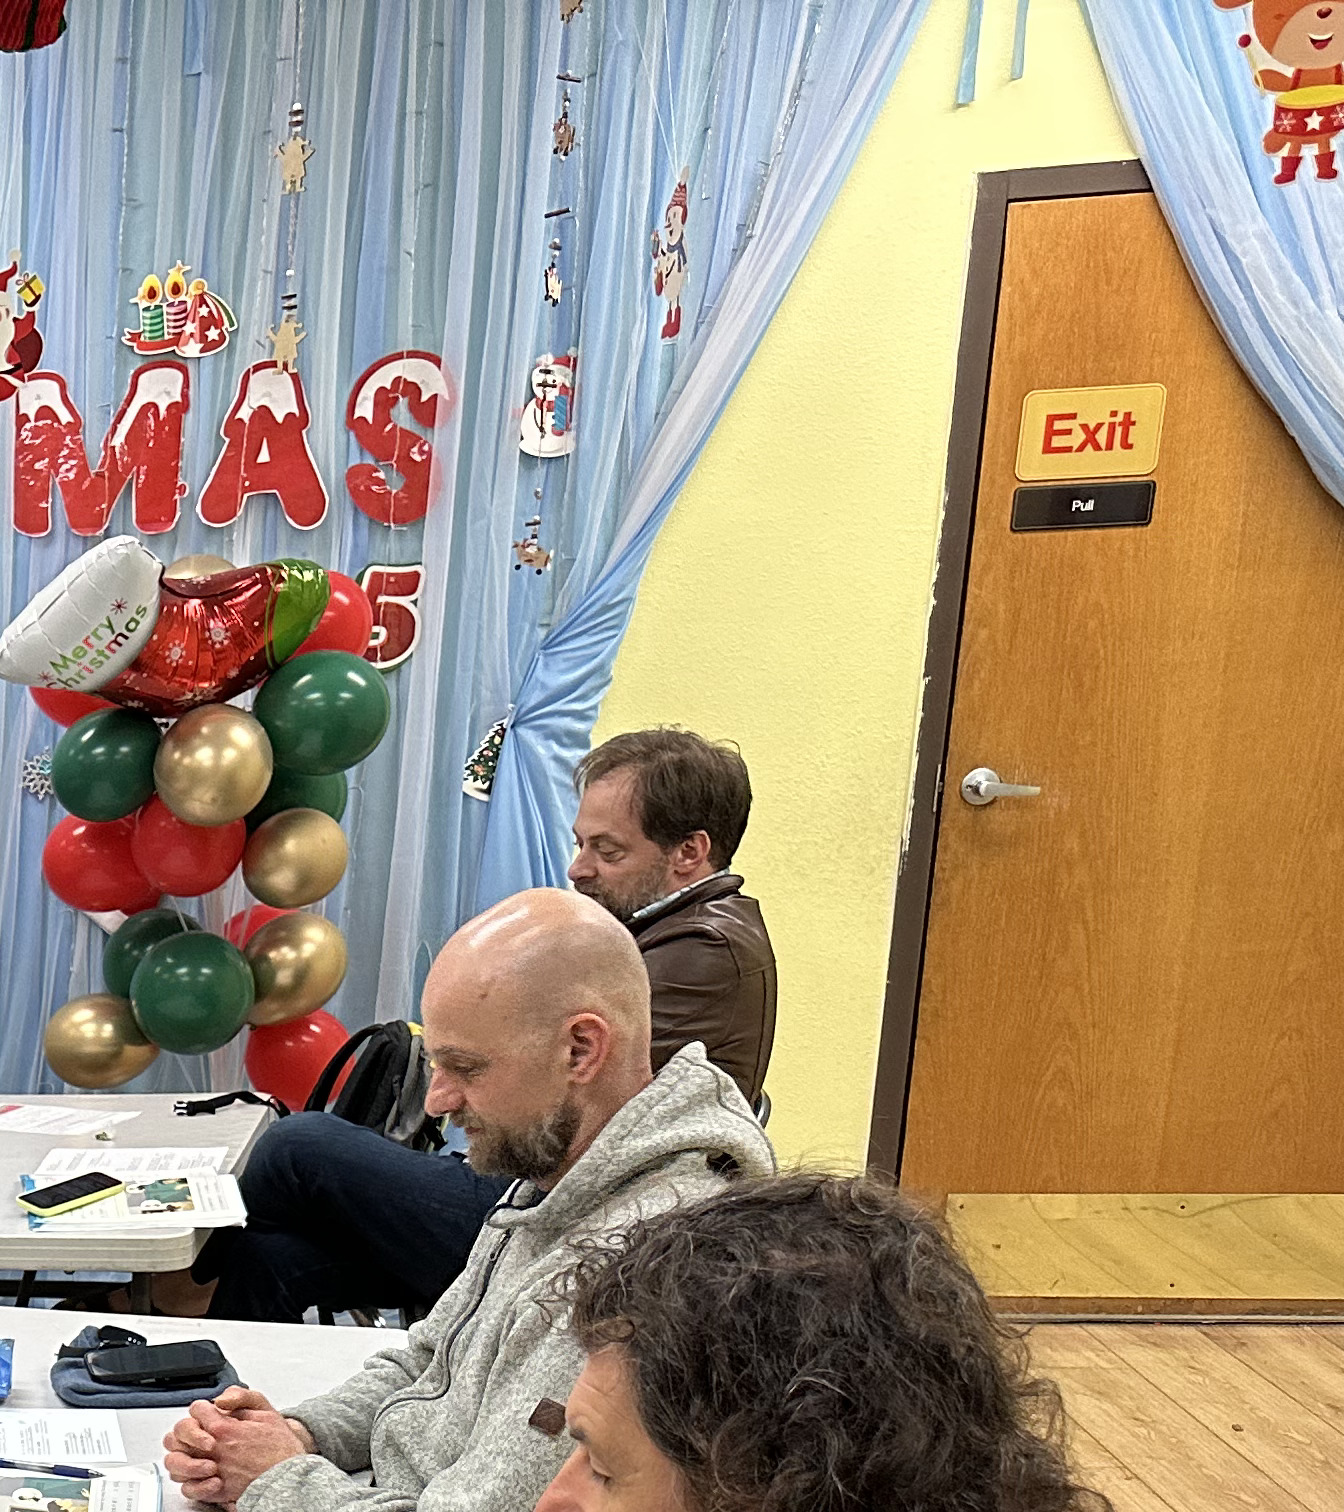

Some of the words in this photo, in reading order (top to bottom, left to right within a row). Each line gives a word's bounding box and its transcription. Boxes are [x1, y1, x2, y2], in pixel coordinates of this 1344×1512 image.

[1042, 410, 1136, 455] Exit
[1071, 499, 1095, 512] Pull
[49, 615, 116, 675] Merry
